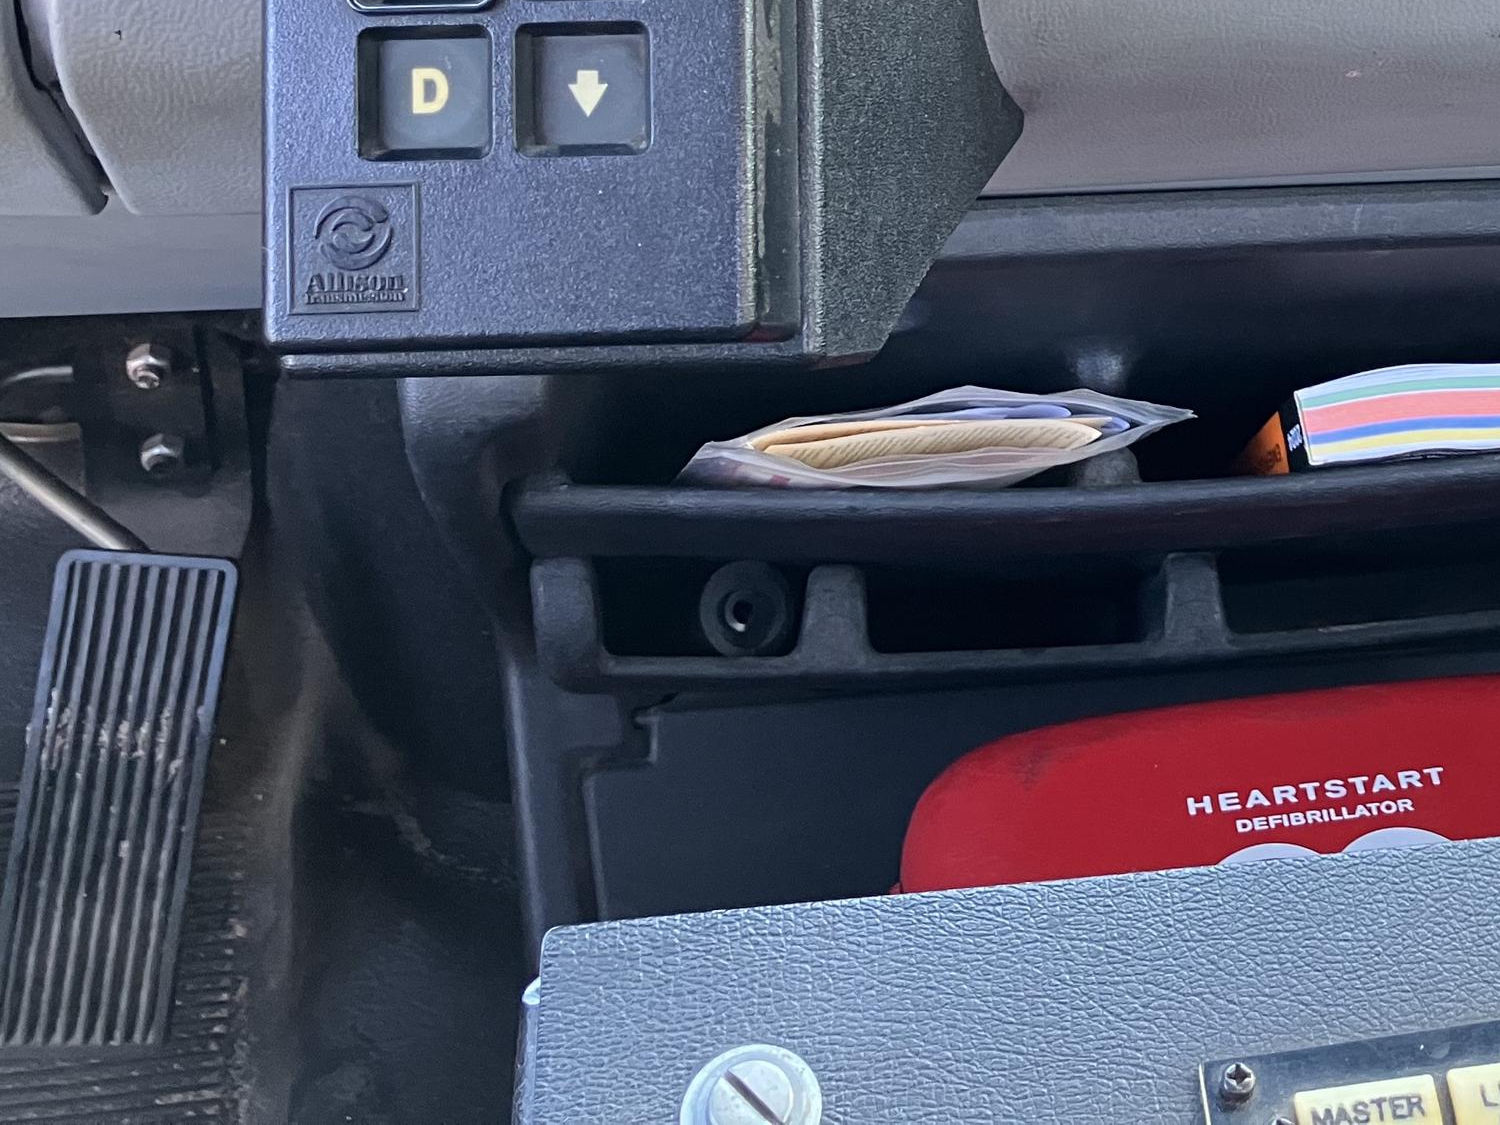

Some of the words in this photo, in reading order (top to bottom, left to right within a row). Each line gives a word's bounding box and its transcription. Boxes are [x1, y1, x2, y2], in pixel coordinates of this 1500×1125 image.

[411, 68, 449, 114] D
[1186, 766, 1444, 816] HEARTSTART
[1235, 798, 1414, 834] DEFIBRILLATOR
[1311, 1093, 1425, 1125] MASTER
